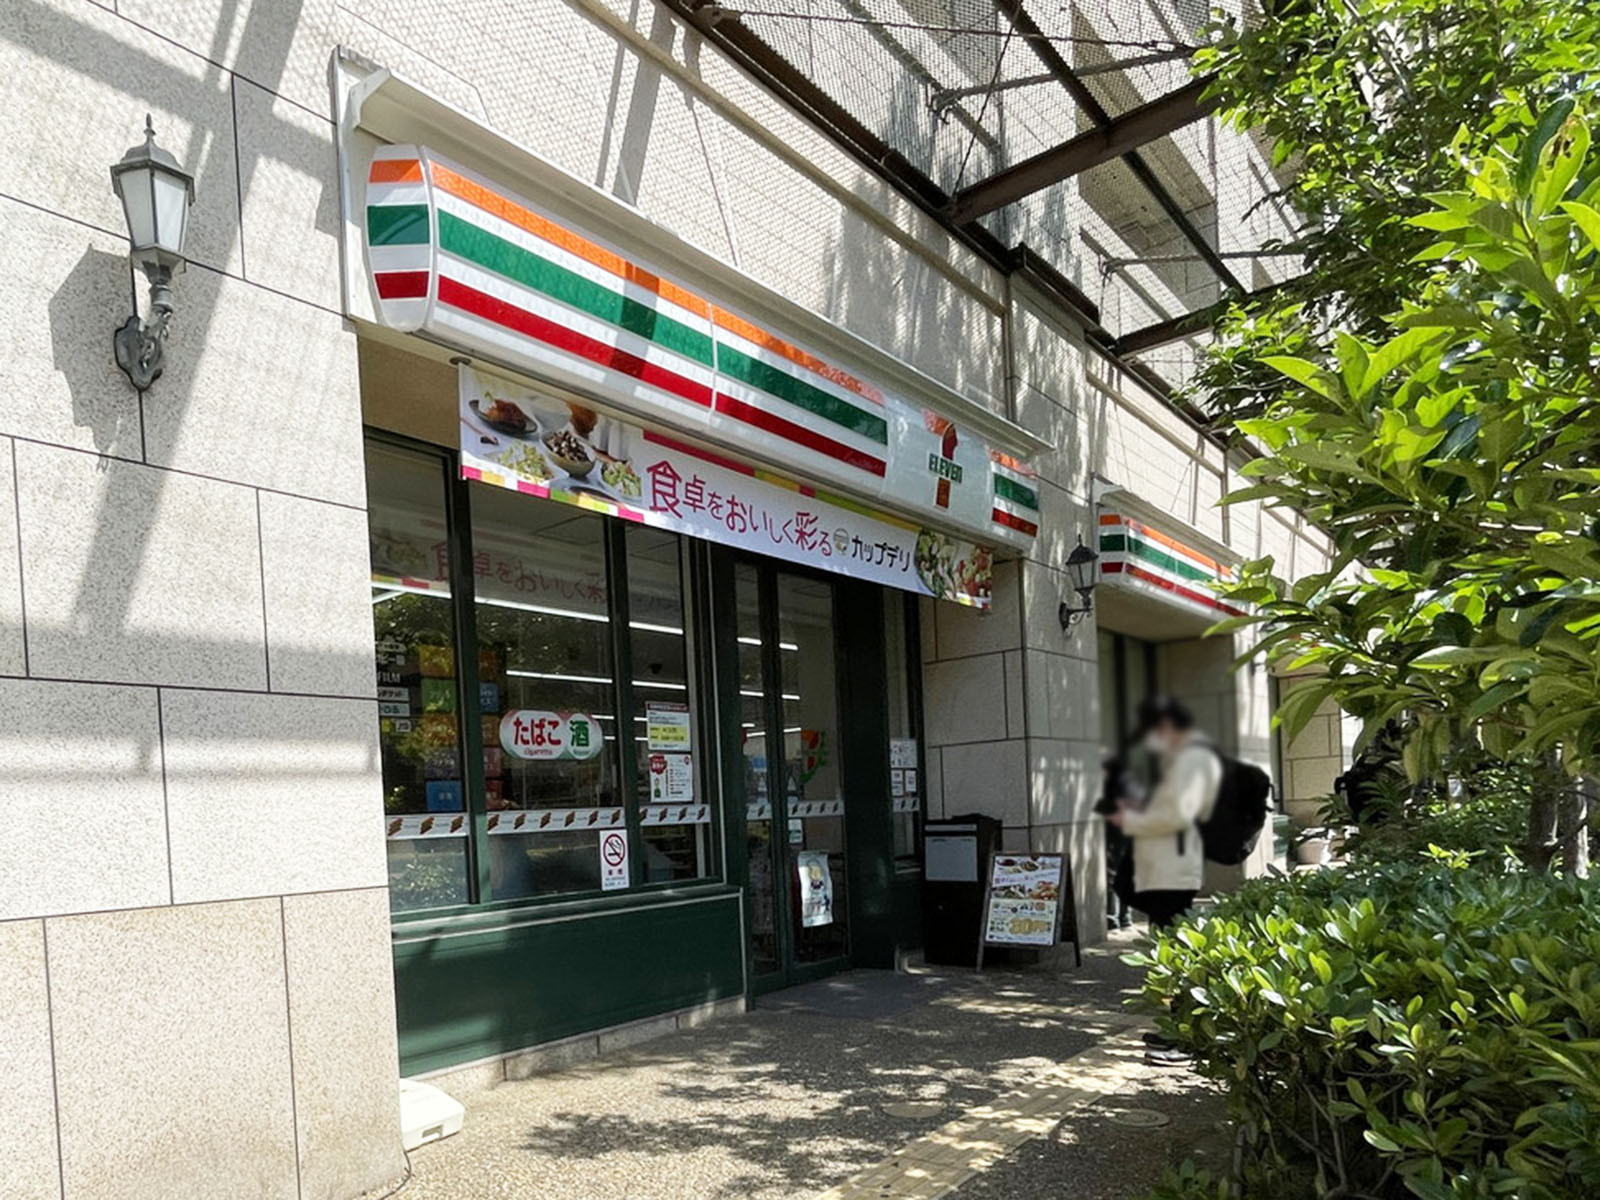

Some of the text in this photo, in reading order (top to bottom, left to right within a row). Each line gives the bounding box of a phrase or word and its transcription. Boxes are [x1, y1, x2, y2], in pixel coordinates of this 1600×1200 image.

[647, 460, 910, 572] 食卓をおいしく彩る カップデリ
[513, 716, 590, 747] たばこ 酒
